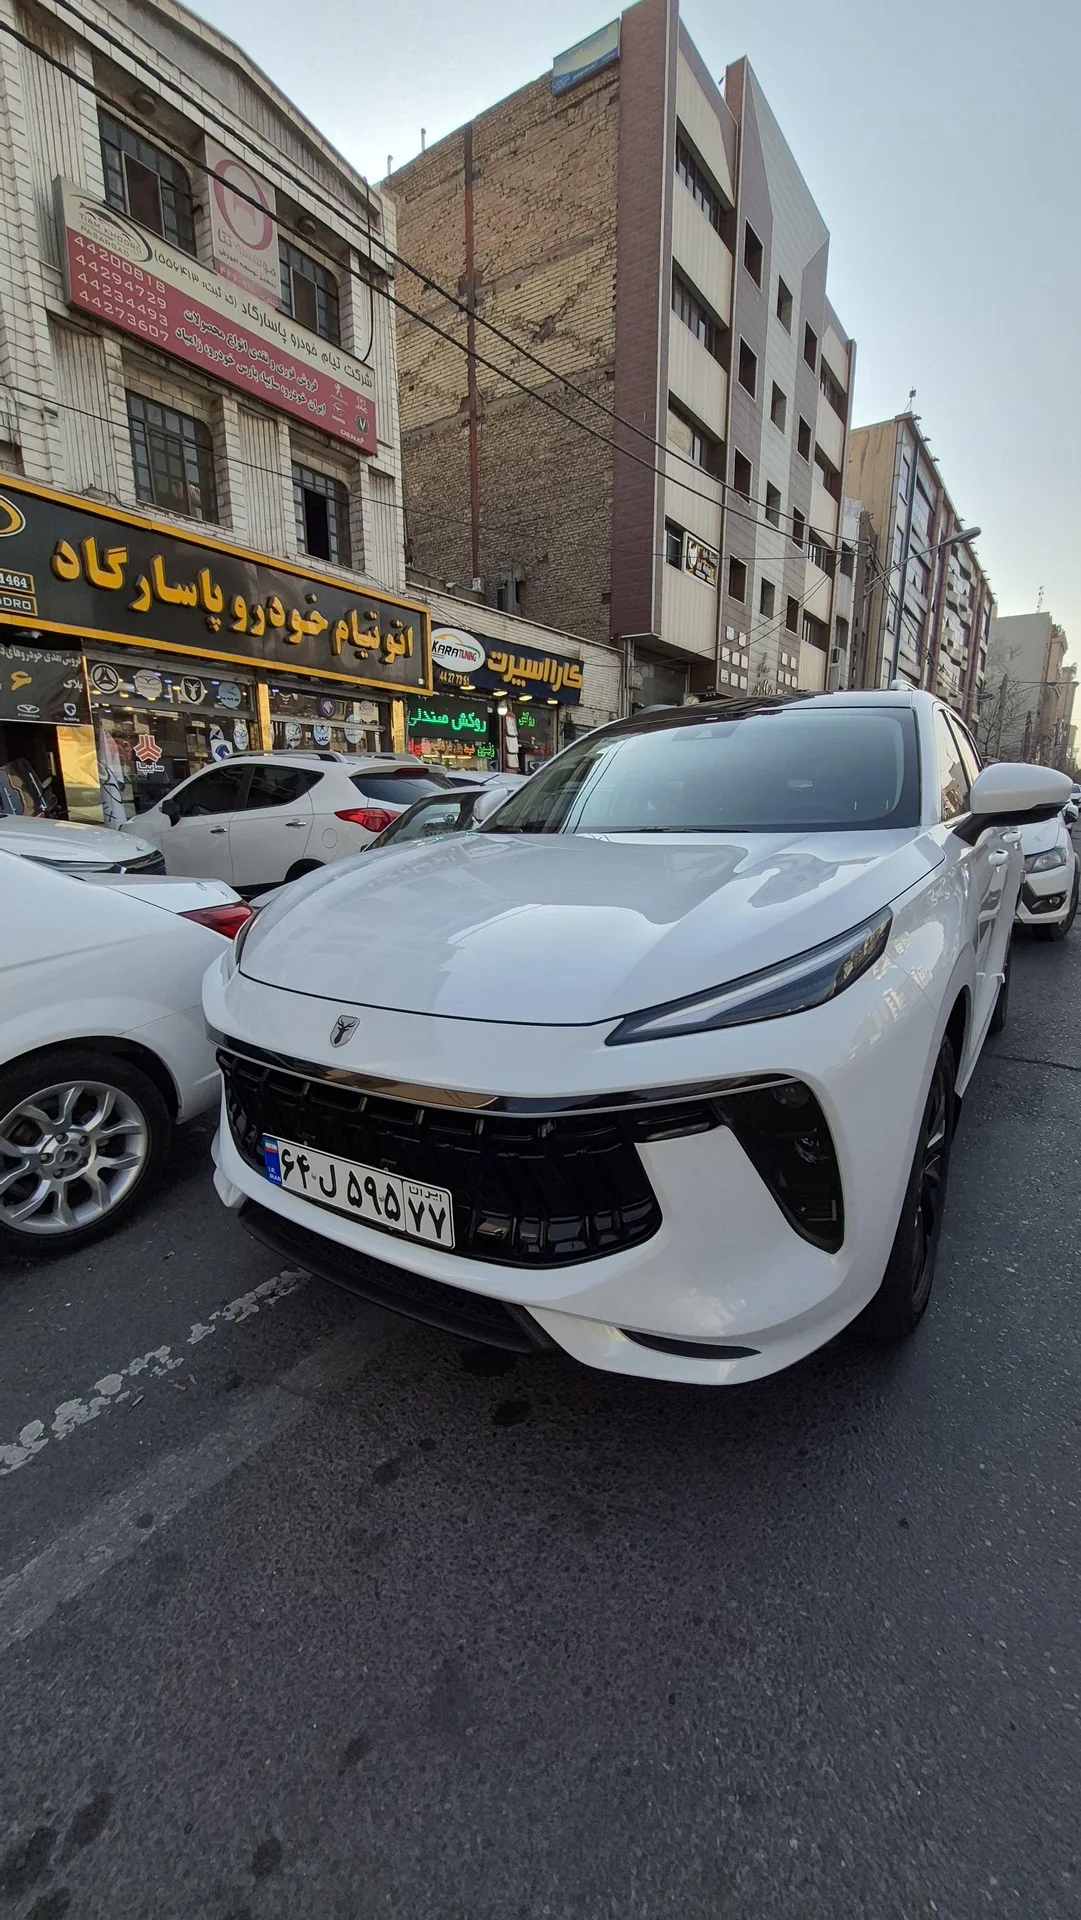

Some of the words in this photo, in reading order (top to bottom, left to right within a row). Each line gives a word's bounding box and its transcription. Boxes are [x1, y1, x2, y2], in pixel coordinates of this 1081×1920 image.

[79, 212, 101, 229] TIAM
[104, 228, 142, 254] KHODRO
[80, 226, 130, 257] PASARGAD
[74, 236, 166, 294] 44200818
[76, 254, 167, 309] 44294729
[77, 272, 168, 327] 44234493
[79, 290, 169, 342] 44273607
[184, 309, 226, 340] محصولات
[242, 303, 287, 345] پاسارگاد
[175, 327, 203, 353] زامیاد
[226, 333, 248, 352] انواع
[290, 333, 318, 356] خودرو
[248, 348, 270, 364] نقدی
[270, 359, 275, 371] و
[321, 352, 341, 371] تیام
[236, 364, 259, 383] پارس
[276, 366, 296, 381] فوری
[296, 373, 318, 392] فروش
[344, 365, 373, 388] شرکت
[307, 399, 327, 416] ایران
[52, 536, 223, 633] پاسارگاد
[0, 597, 31, 610] DRO
[229, 592, 329, 644] خودرو
[332, 609, 381, 660] تیام
[384, 617, 413, 665] اتو
[62, 652, 81, 667] فروش
[11, 671, 32, 691] ۶
[63, 679, 83, 692] پلاک
[408, 708, 449, 727] صندلی
[452, 711, 487, 733] روکش
[136, 761, 164, 775] سایپا
[408, 1185, 442, 1203] ایران
[408, 1196, 446, 1239] ۷۷
